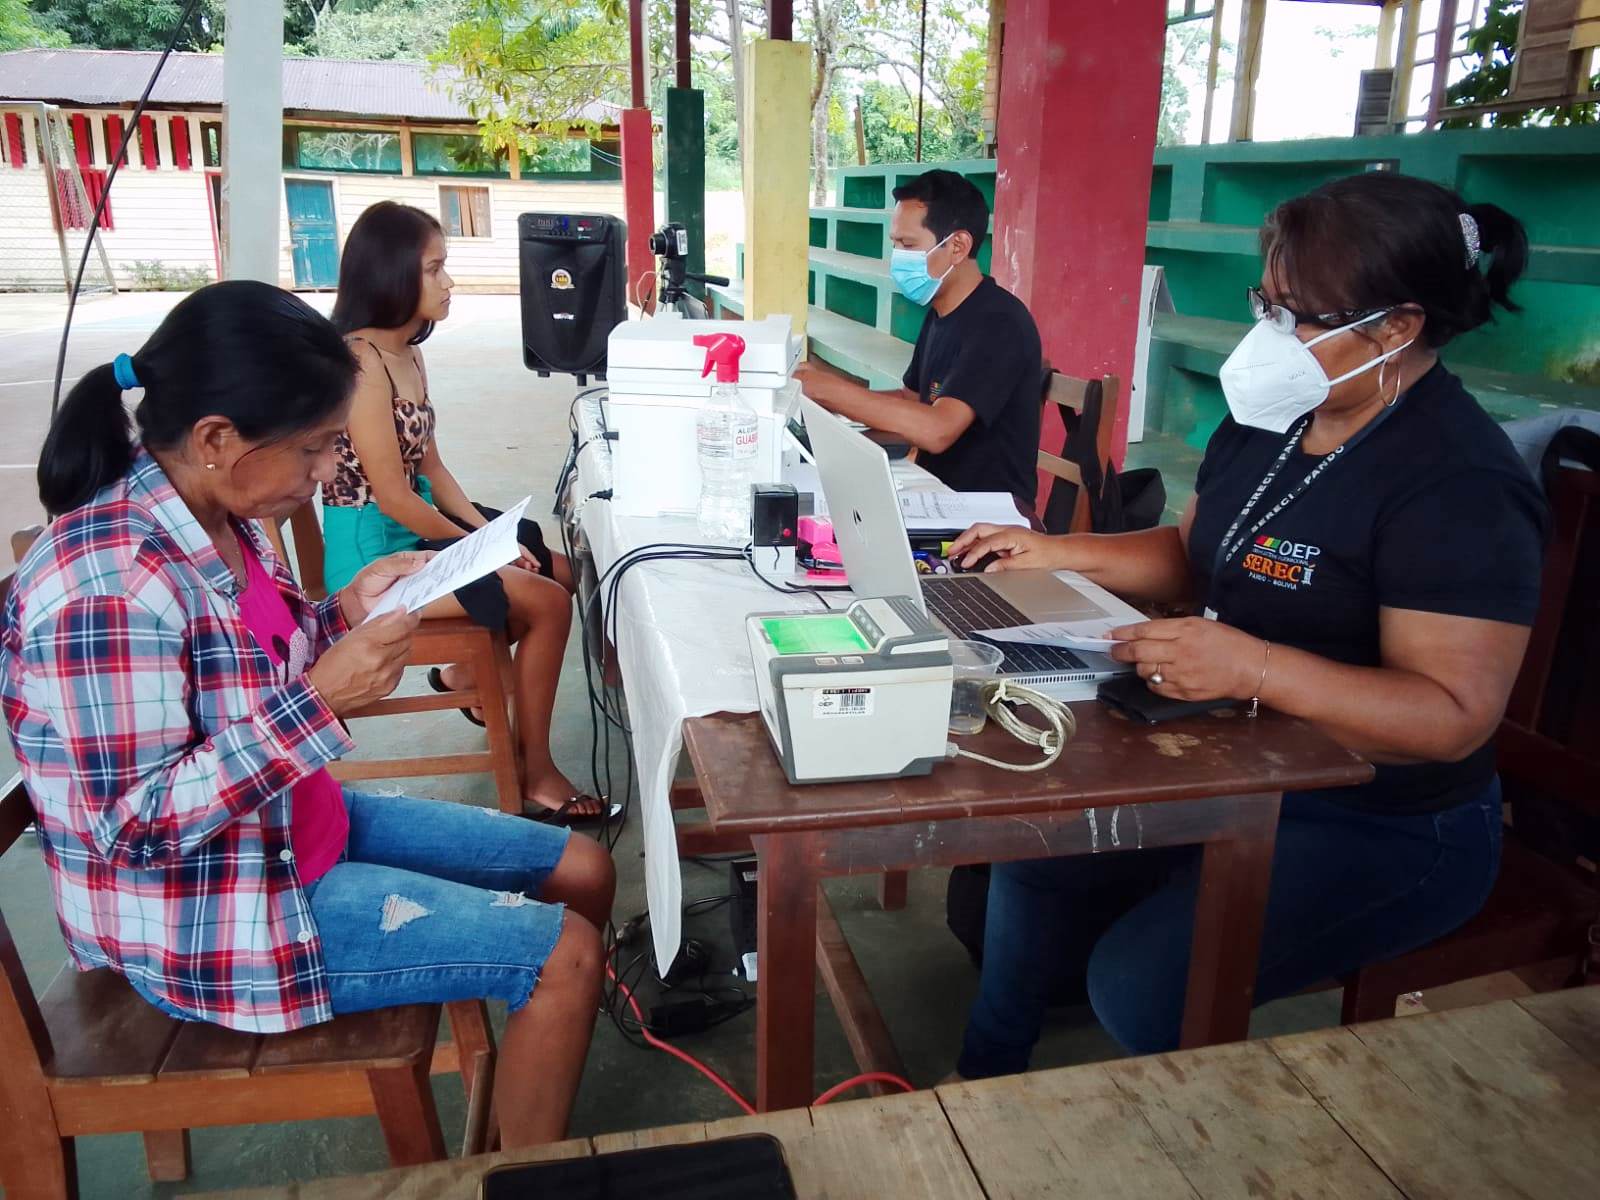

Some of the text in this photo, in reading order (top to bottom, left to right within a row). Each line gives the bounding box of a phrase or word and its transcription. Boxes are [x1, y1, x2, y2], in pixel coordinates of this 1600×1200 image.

[1241, 472, 1276, 516] SERECI
[1251, 493, 1294, 533] SERECI
[1304, 445, 1345, 485] PANDO
[1278, 540, 1321, 560] OEP
[1272, 579, 1297, 590] BOLIVIA
